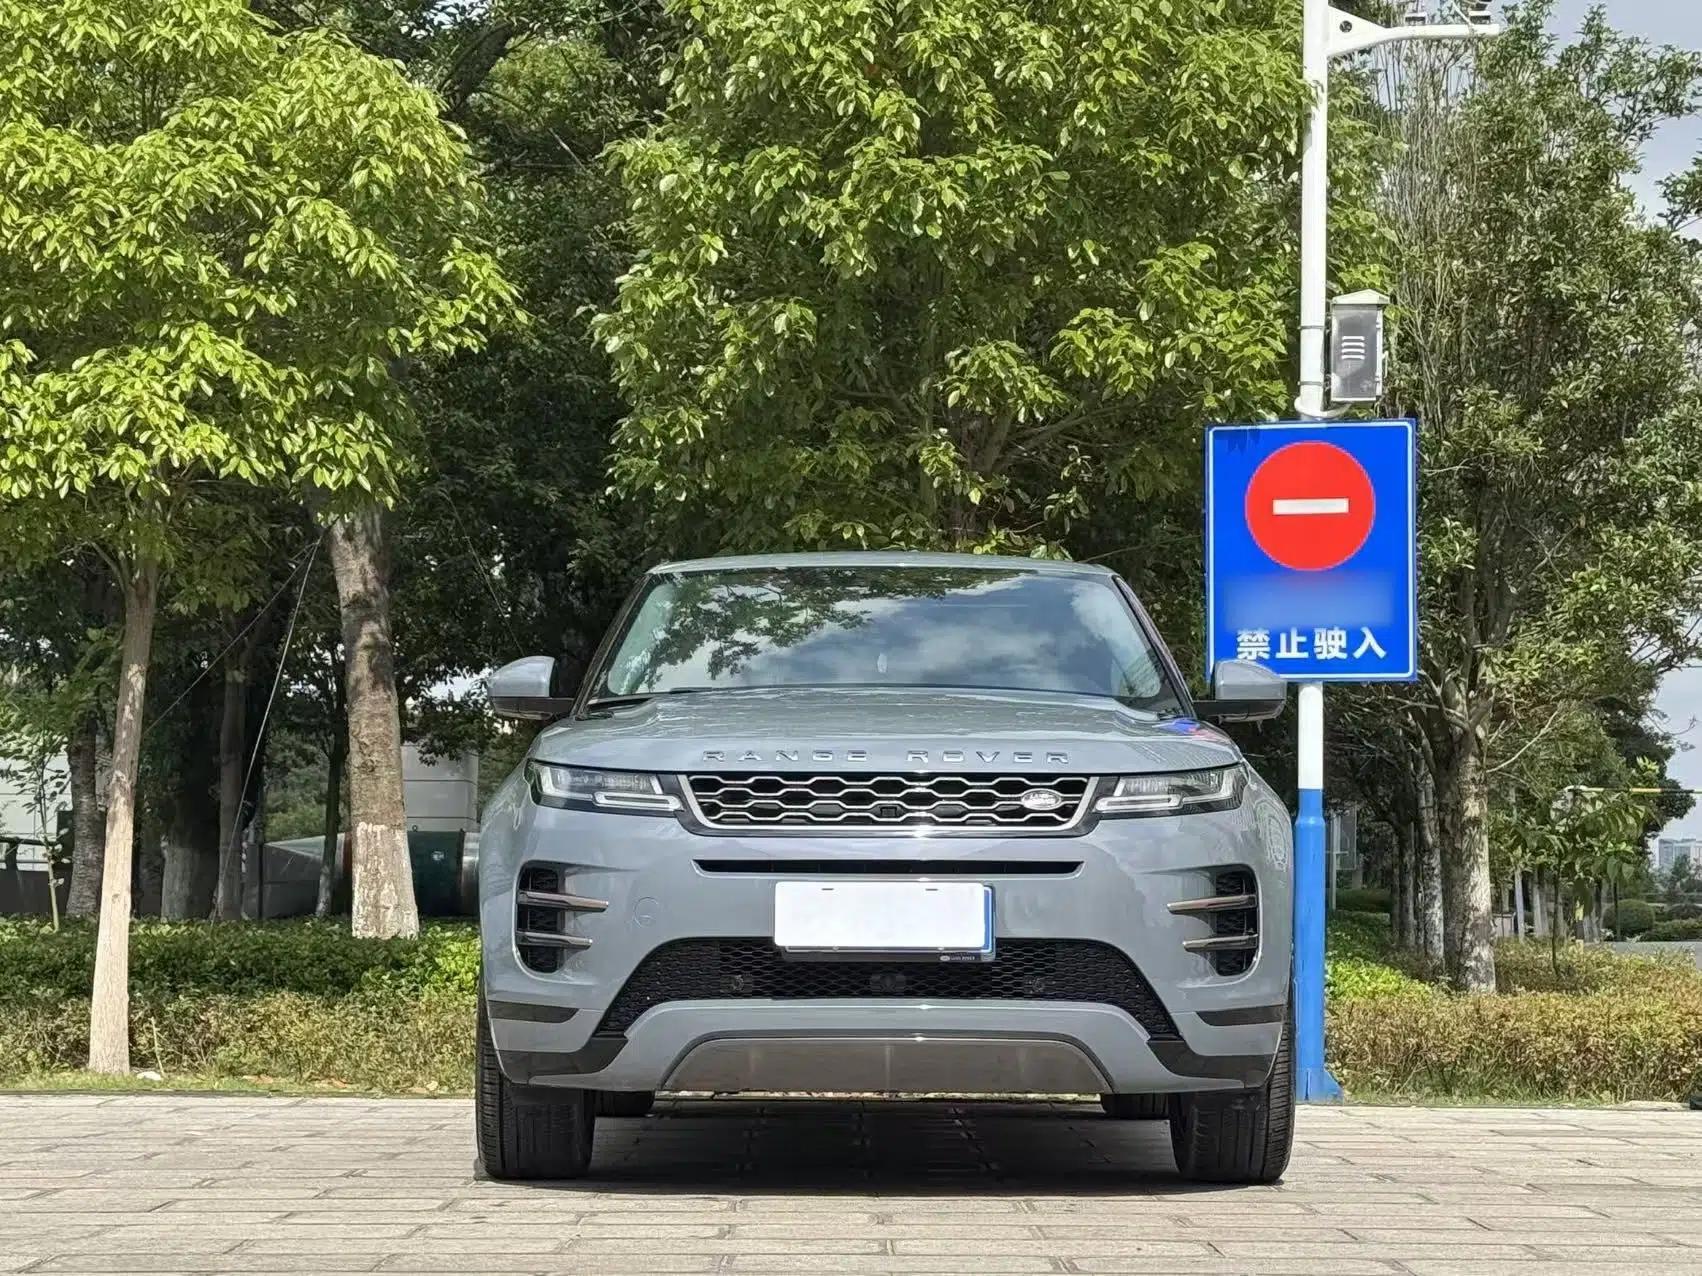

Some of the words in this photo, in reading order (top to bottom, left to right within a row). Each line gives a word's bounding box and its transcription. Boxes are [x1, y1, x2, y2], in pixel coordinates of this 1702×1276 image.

[1236, 626, 1387, 660] 禁止驶入
[702, 750, 867, 762] RANGE
[906, 750, 1069, 764] ROVER
